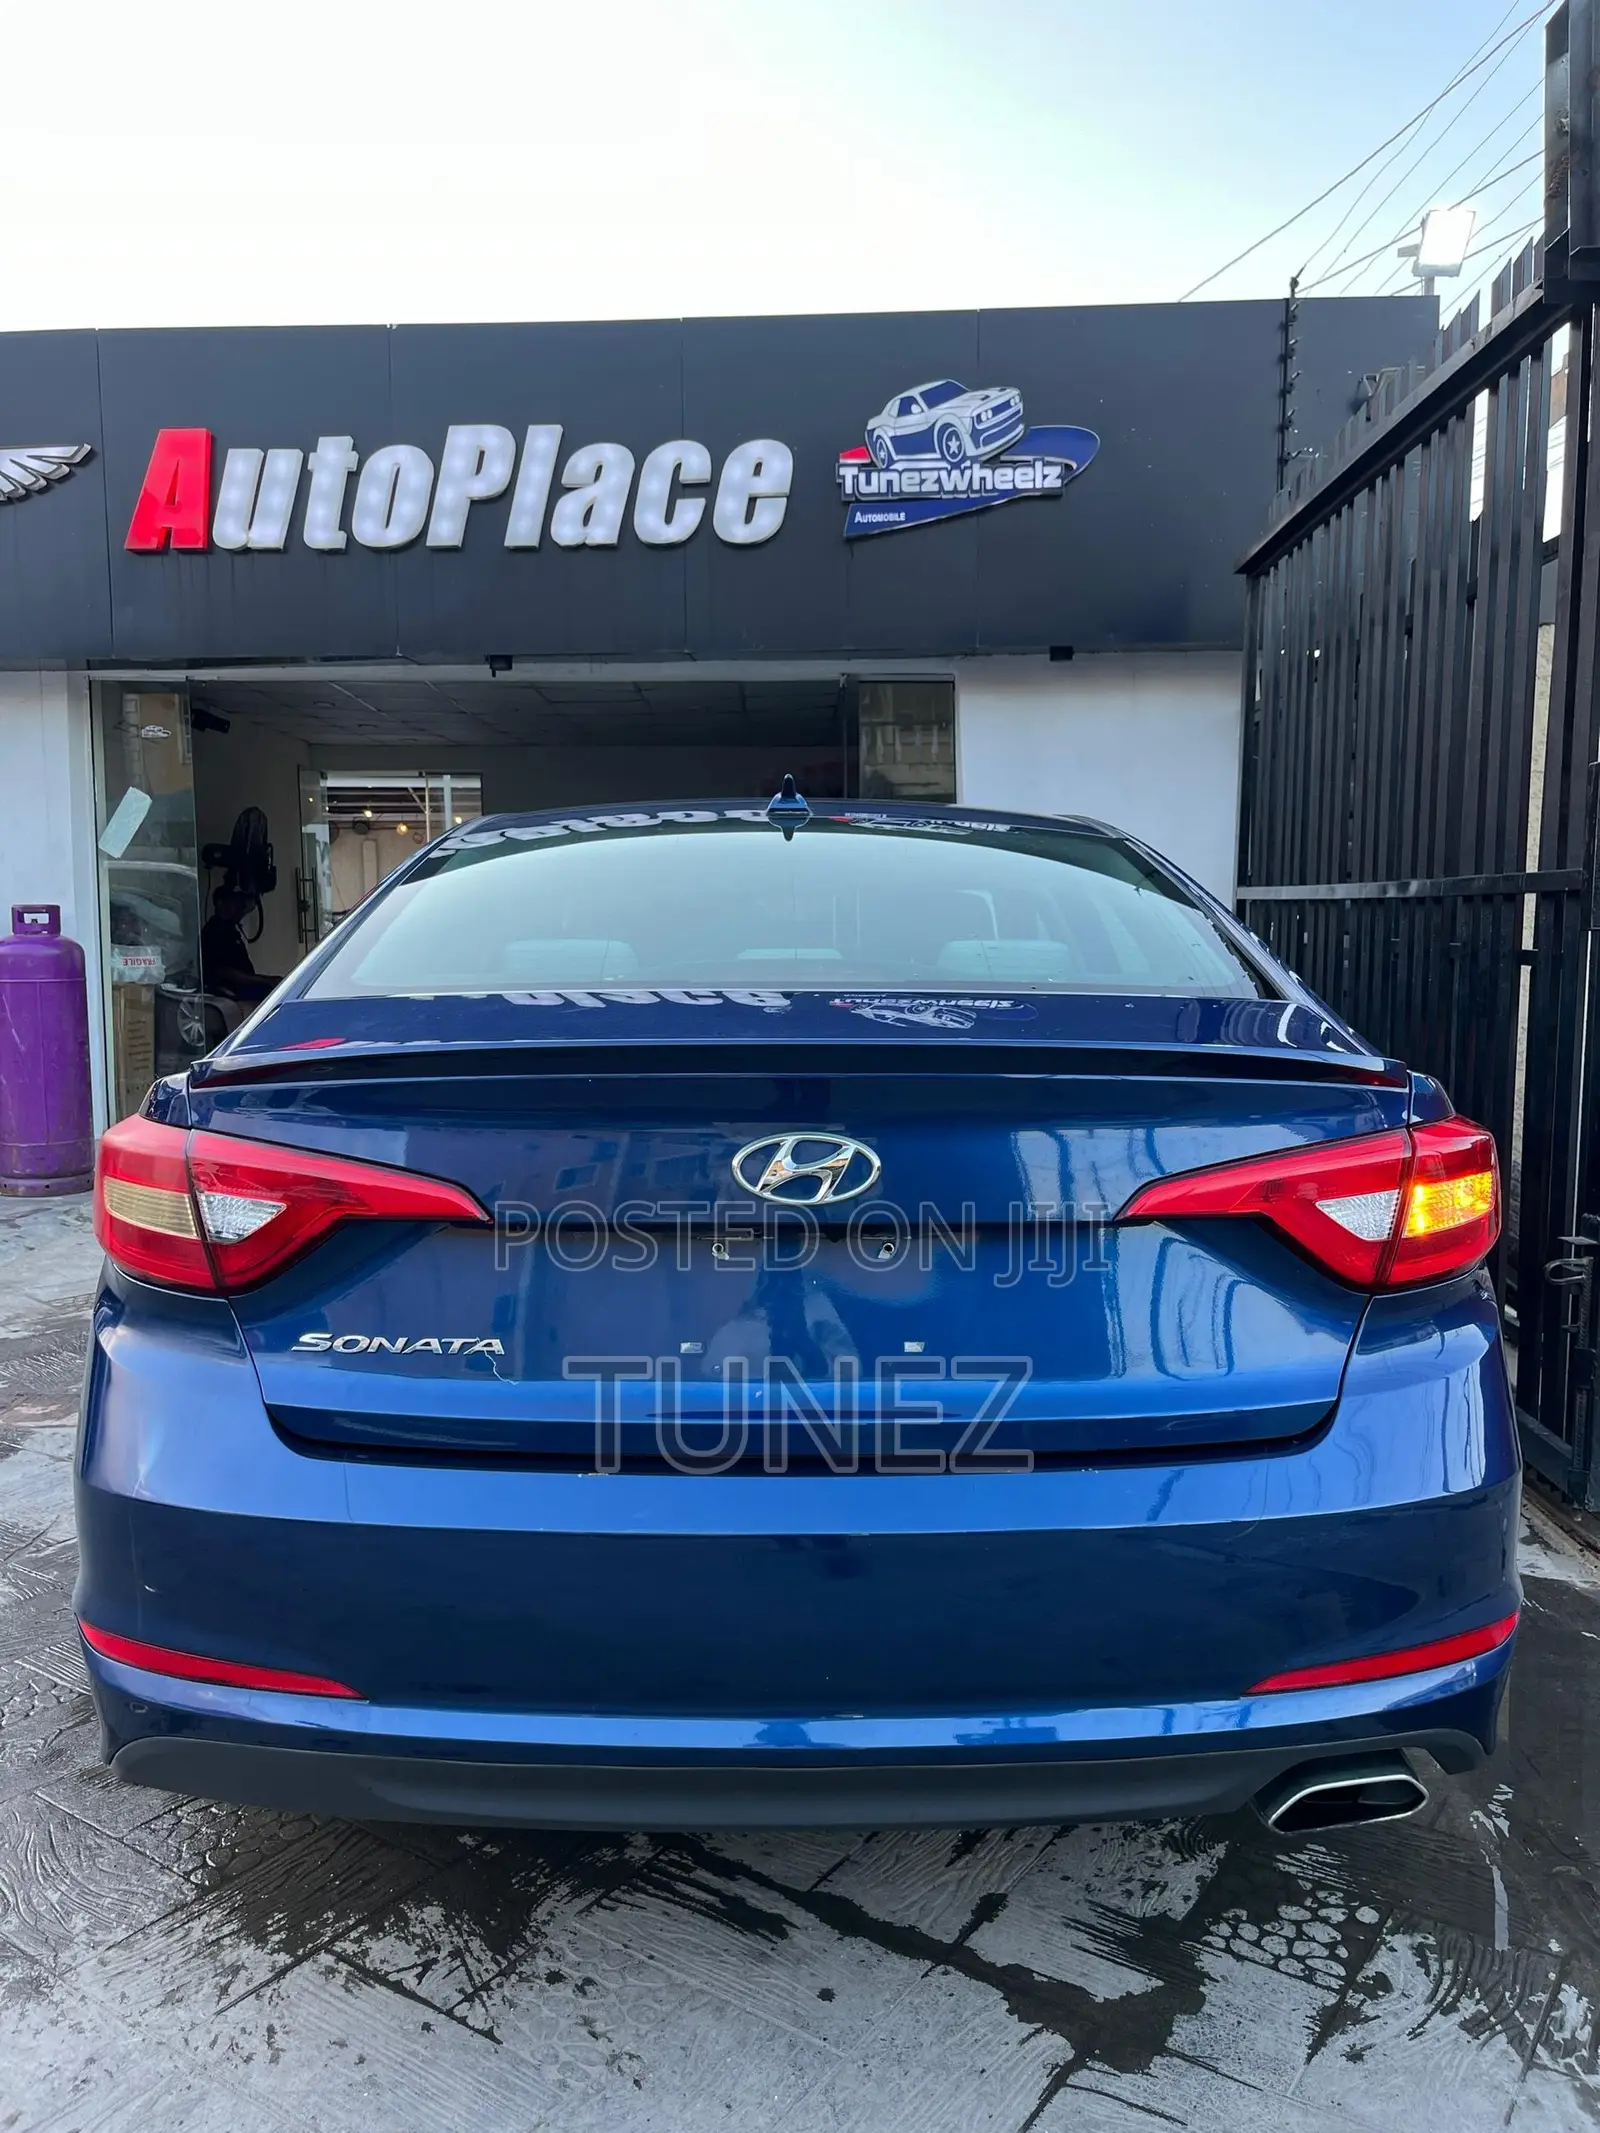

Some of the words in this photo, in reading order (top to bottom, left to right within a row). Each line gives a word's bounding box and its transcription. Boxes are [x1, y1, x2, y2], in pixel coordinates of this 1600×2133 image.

[124, 424, 793, 551] AutoPlace
[854, 511, 906, 523] AUTOMOBILE
[122, 957, 156, 967] FRAGILE
[291, 1333, 505, 1355] SONATA
